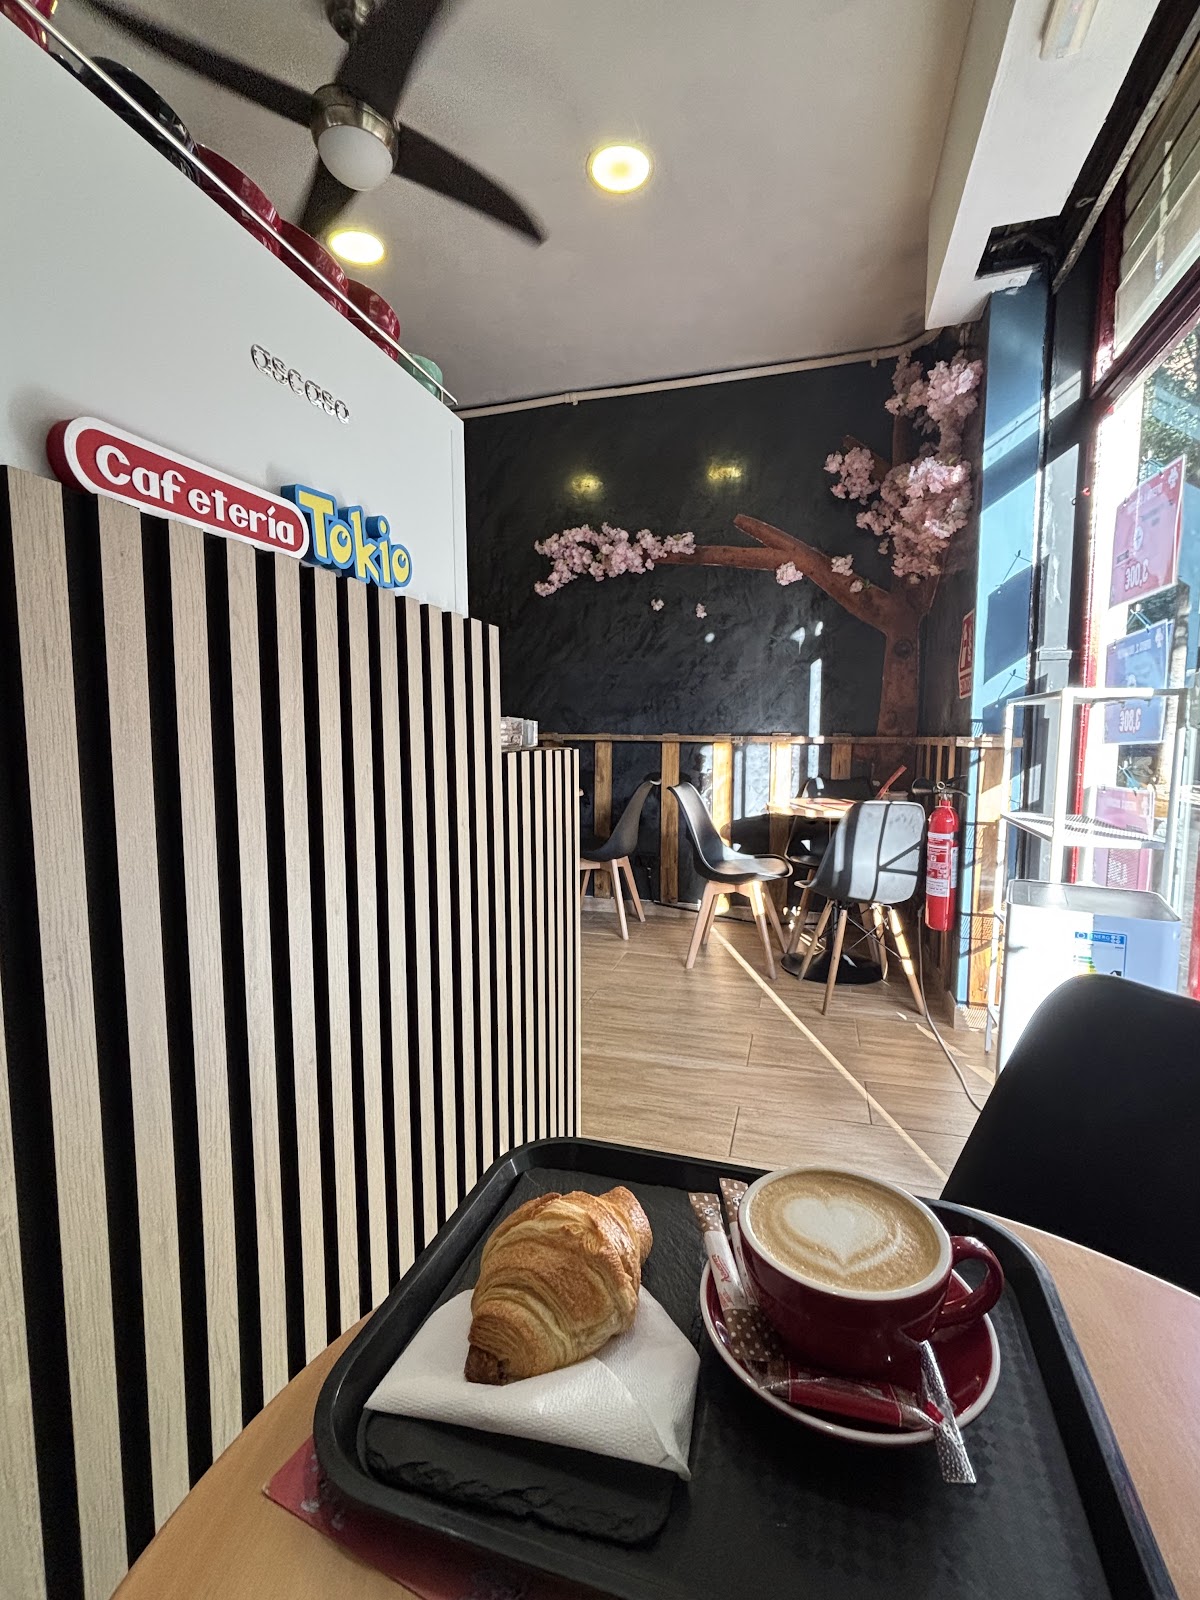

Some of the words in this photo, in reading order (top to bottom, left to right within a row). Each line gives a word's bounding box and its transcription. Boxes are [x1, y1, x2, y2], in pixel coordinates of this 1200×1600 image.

[250, 343, 350, 425] ascaso
[95, 444, 295, 546] Cafetería
[297, 489, 412, 586] Tokio
